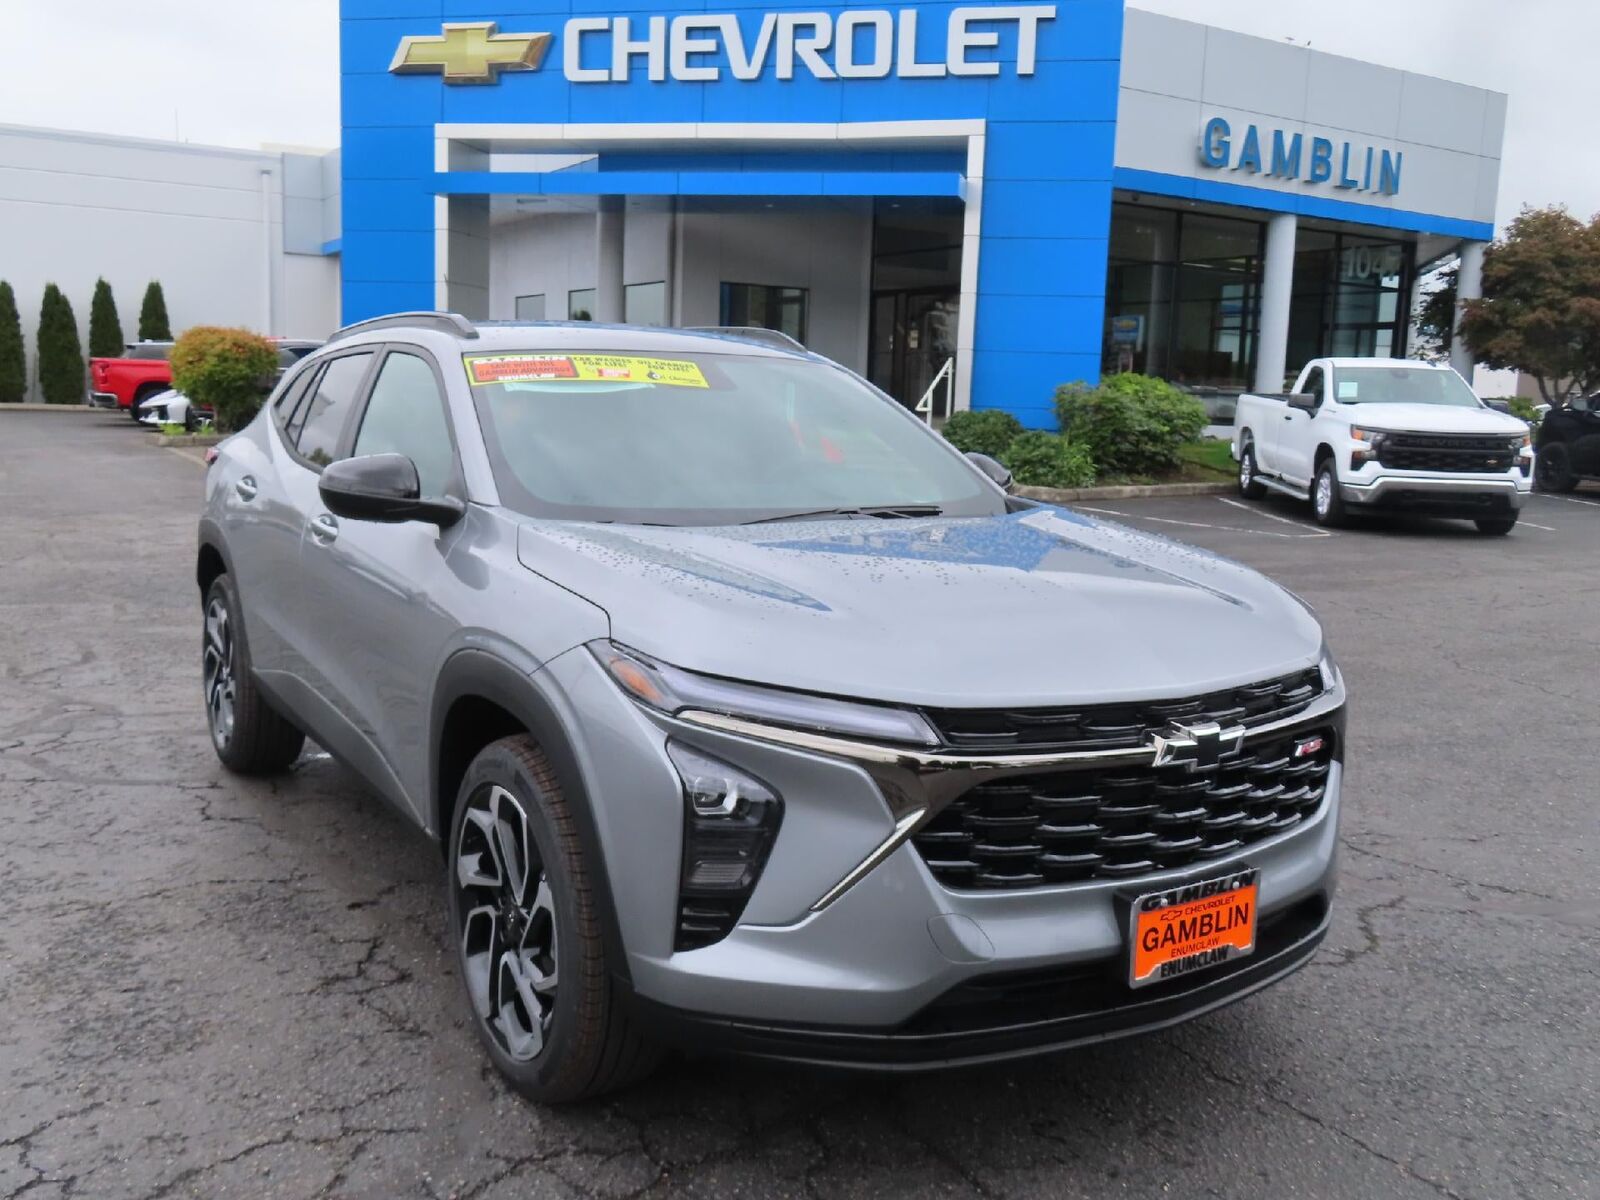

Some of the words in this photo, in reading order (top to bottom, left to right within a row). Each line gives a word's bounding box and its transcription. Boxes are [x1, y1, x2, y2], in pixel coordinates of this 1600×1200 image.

[563, 5, 1056, 83] CHEVROLET
[1201, 117, 1402, 195] GAMBLIN
[1185, 895, 1236, 915] CHEVROLET
[1142, 902, 1249, 952] GAMBLIN
[1170, 936, 1220, 958] ENUMCLAW
[1160, 945, 1230, 978] ENUMCLAW
